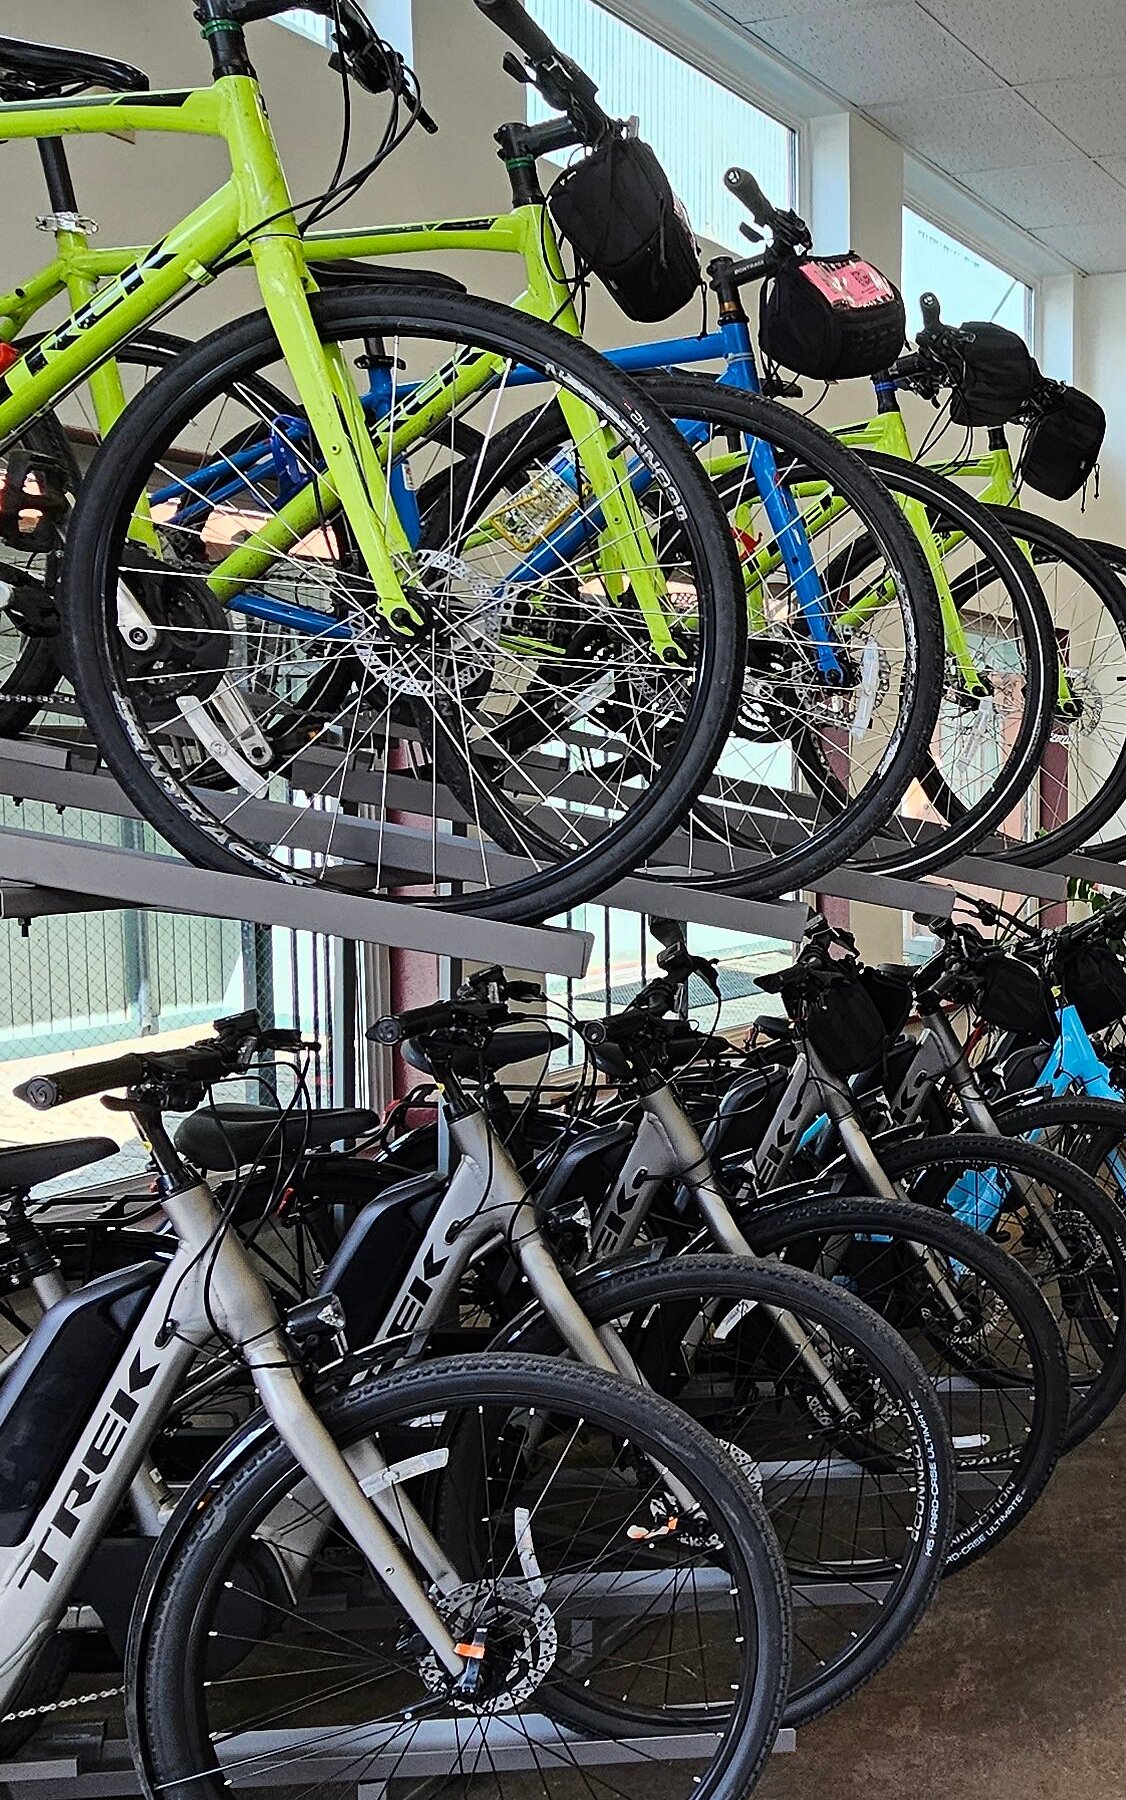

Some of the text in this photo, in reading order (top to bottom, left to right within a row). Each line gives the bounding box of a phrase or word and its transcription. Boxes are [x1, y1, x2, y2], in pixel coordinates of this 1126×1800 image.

[370, 345, 487, 449] REK
[385, 1242, 450, 1338] EK
[911, 1400, 936, 1459] ULTIMATE
[18, 1346, 161, 1589] TREK
[929, 1462, 940, 1535] HARD-CASE
[950, 1482, 1016, 1547] NNECTION
[985, 1494, 1023, 1536] ULTIMATE
